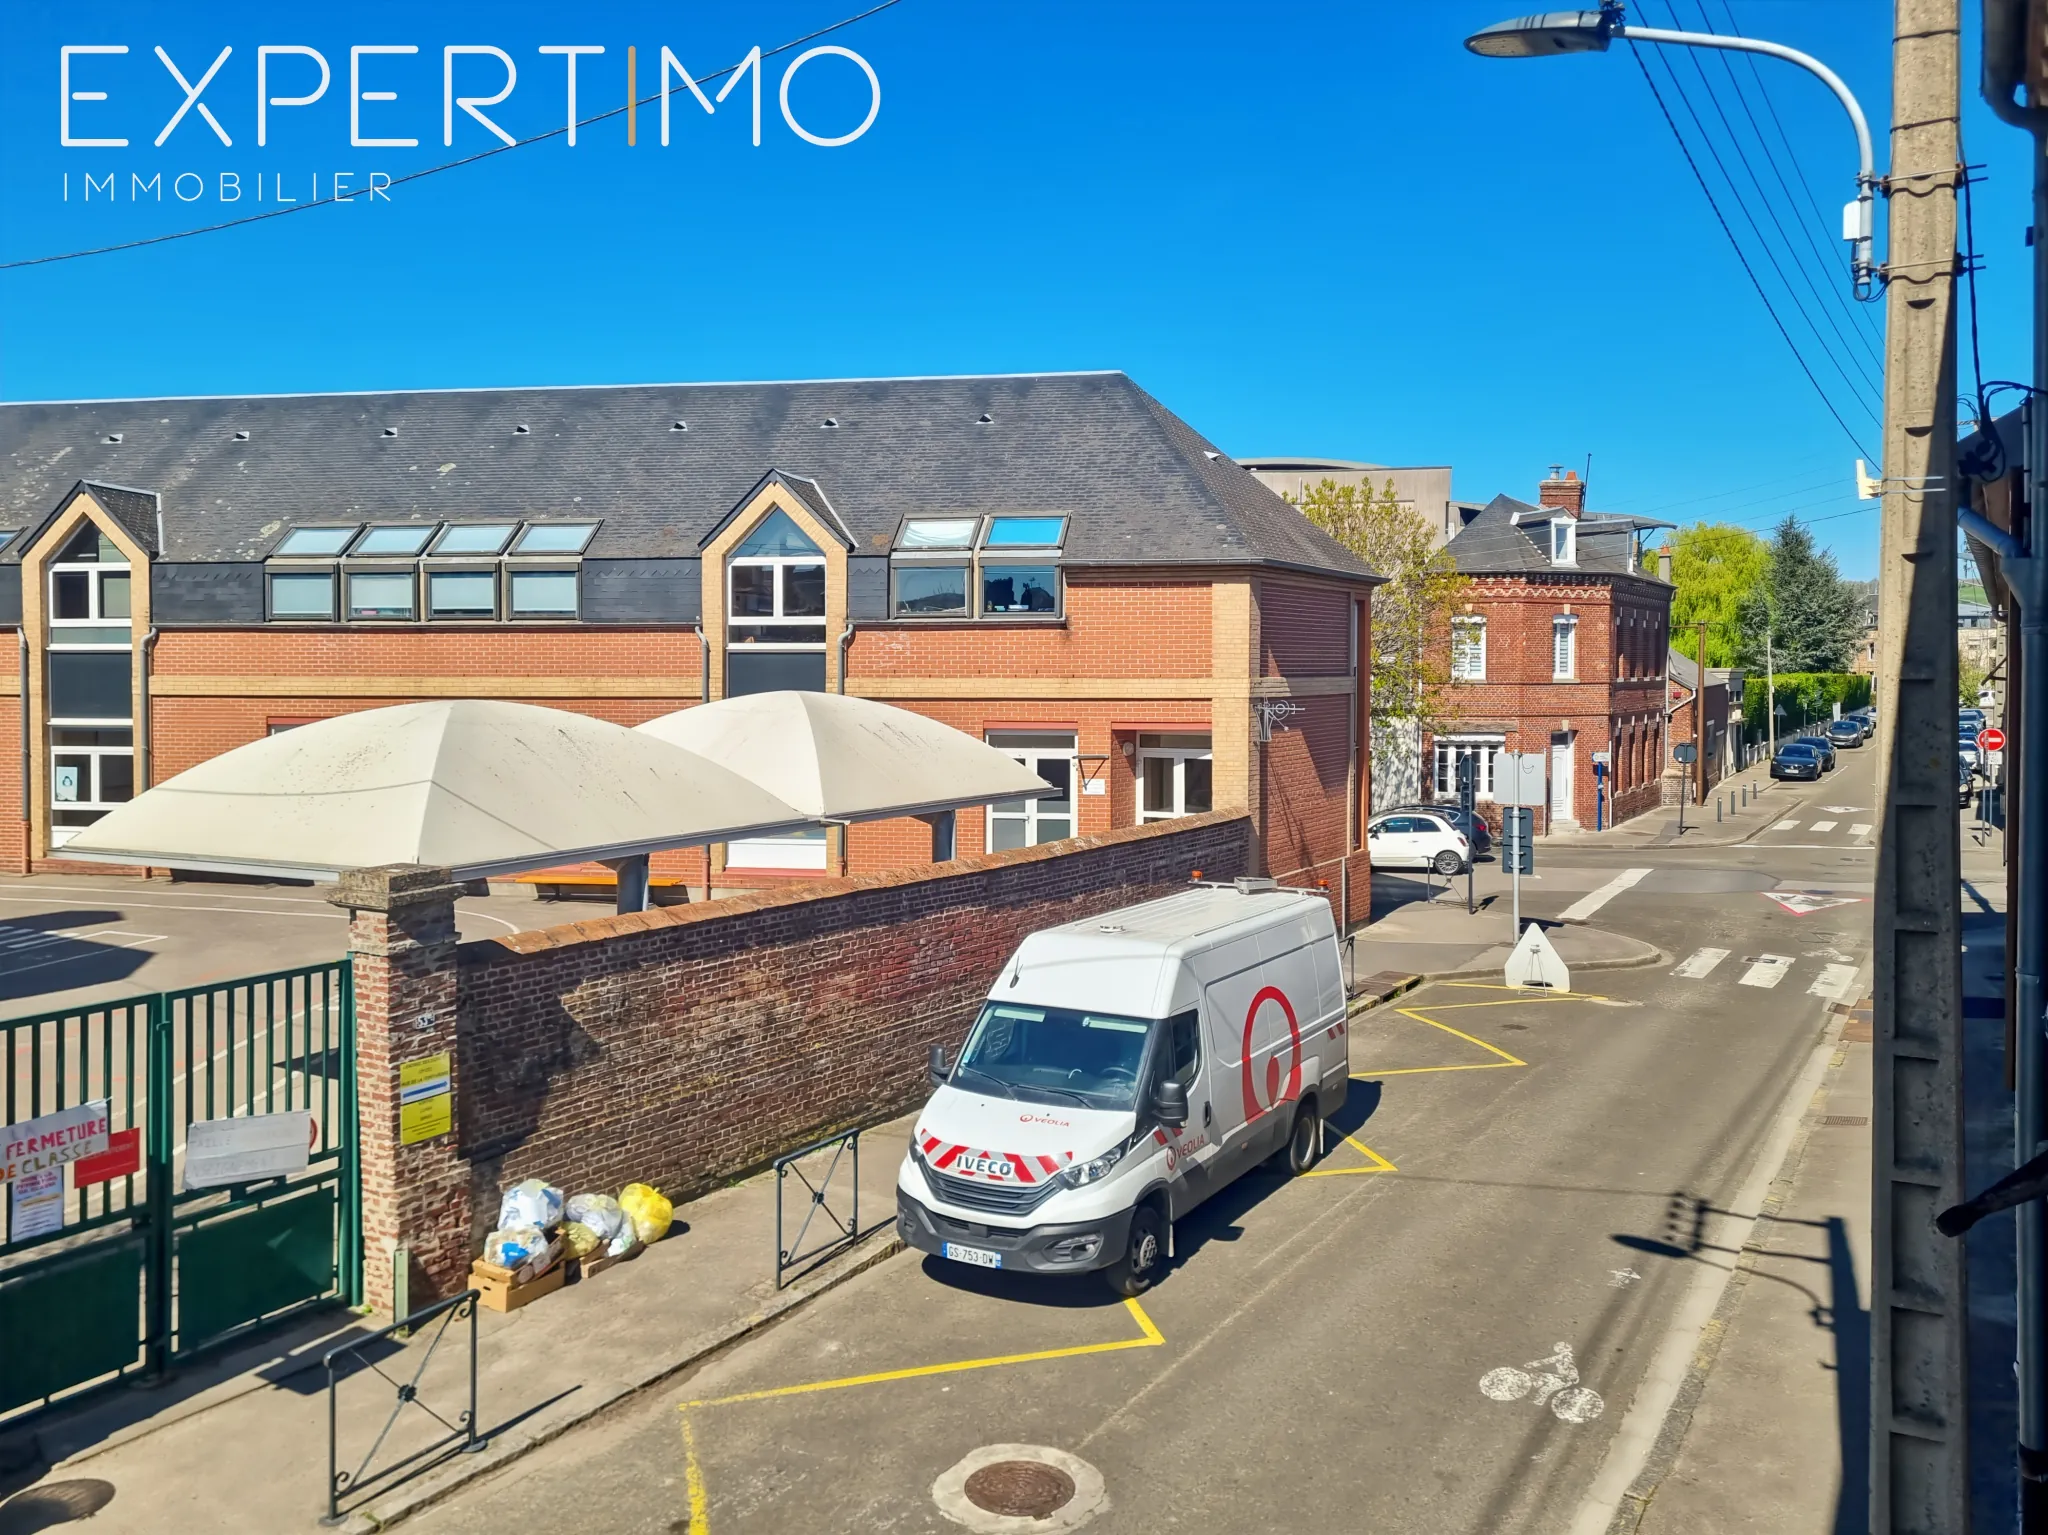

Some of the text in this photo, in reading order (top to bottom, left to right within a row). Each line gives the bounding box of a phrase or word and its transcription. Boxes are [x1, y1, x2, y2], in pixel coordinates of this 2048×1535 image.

[1034, 1117, 1070, 1128] VEOLIA
[6, 1117, 107, 1161] FERMETURE
[1176, 1133, 1205, 1159] VEOLIA
[22, 1140, 93, 1175] CLASSE
[956, 1155, 1013, 1177] IVECO
